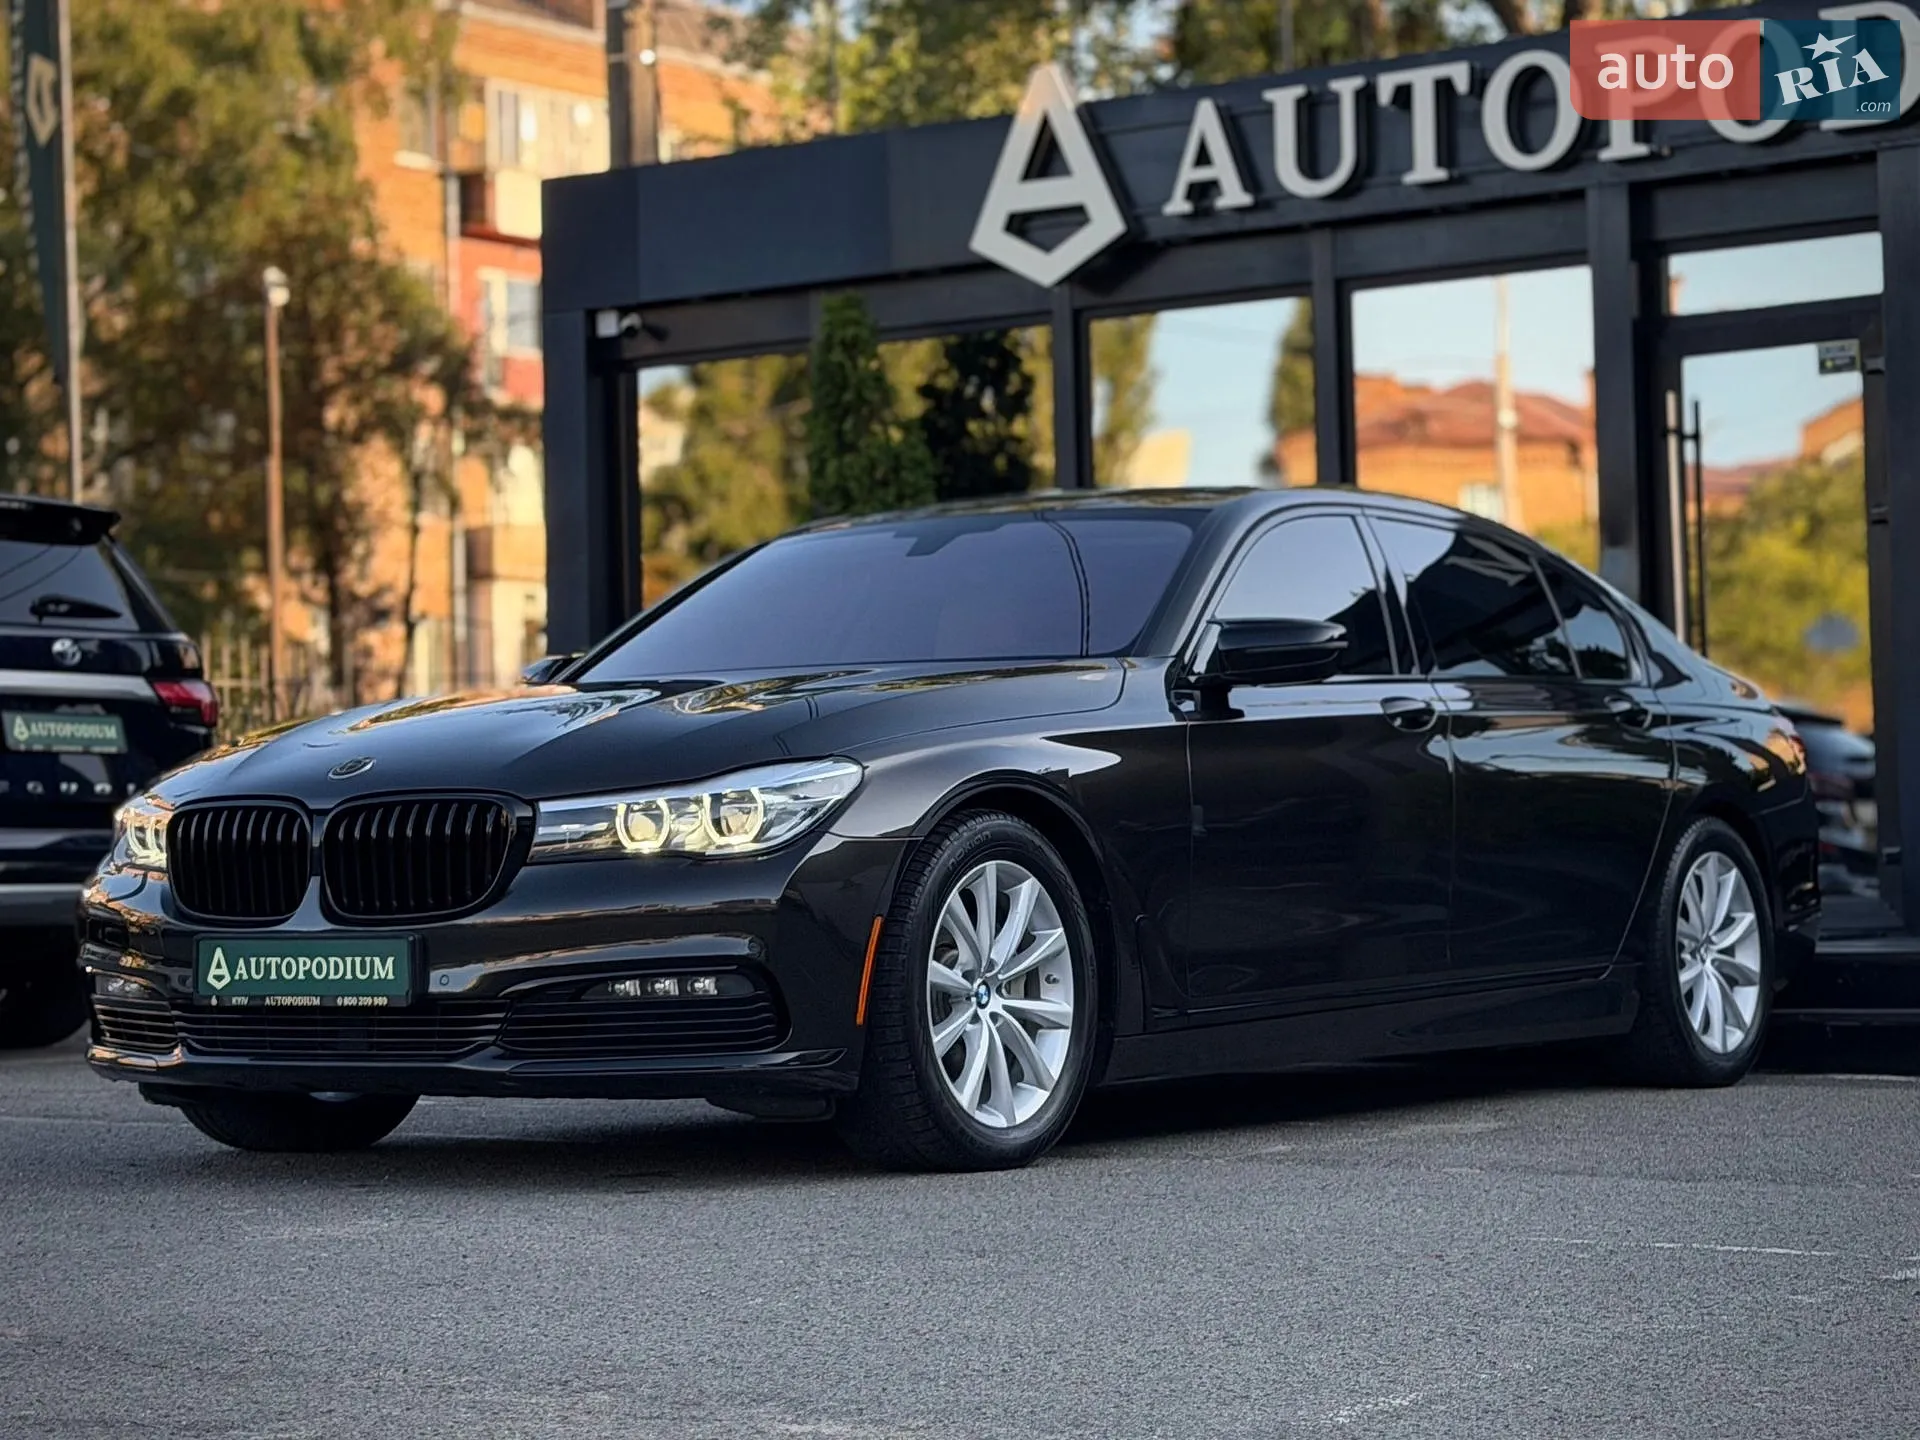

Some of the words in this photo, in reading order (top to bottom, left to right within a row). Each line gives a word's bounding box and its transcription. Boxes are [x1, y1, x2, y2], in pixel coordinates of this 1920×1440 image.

[30, 721, 118, 739] AUTOPODIUM
[234, 956, 396, 980] AUTOPODIUM
[264, 996, 321, 1007] AUTOPODIUM
